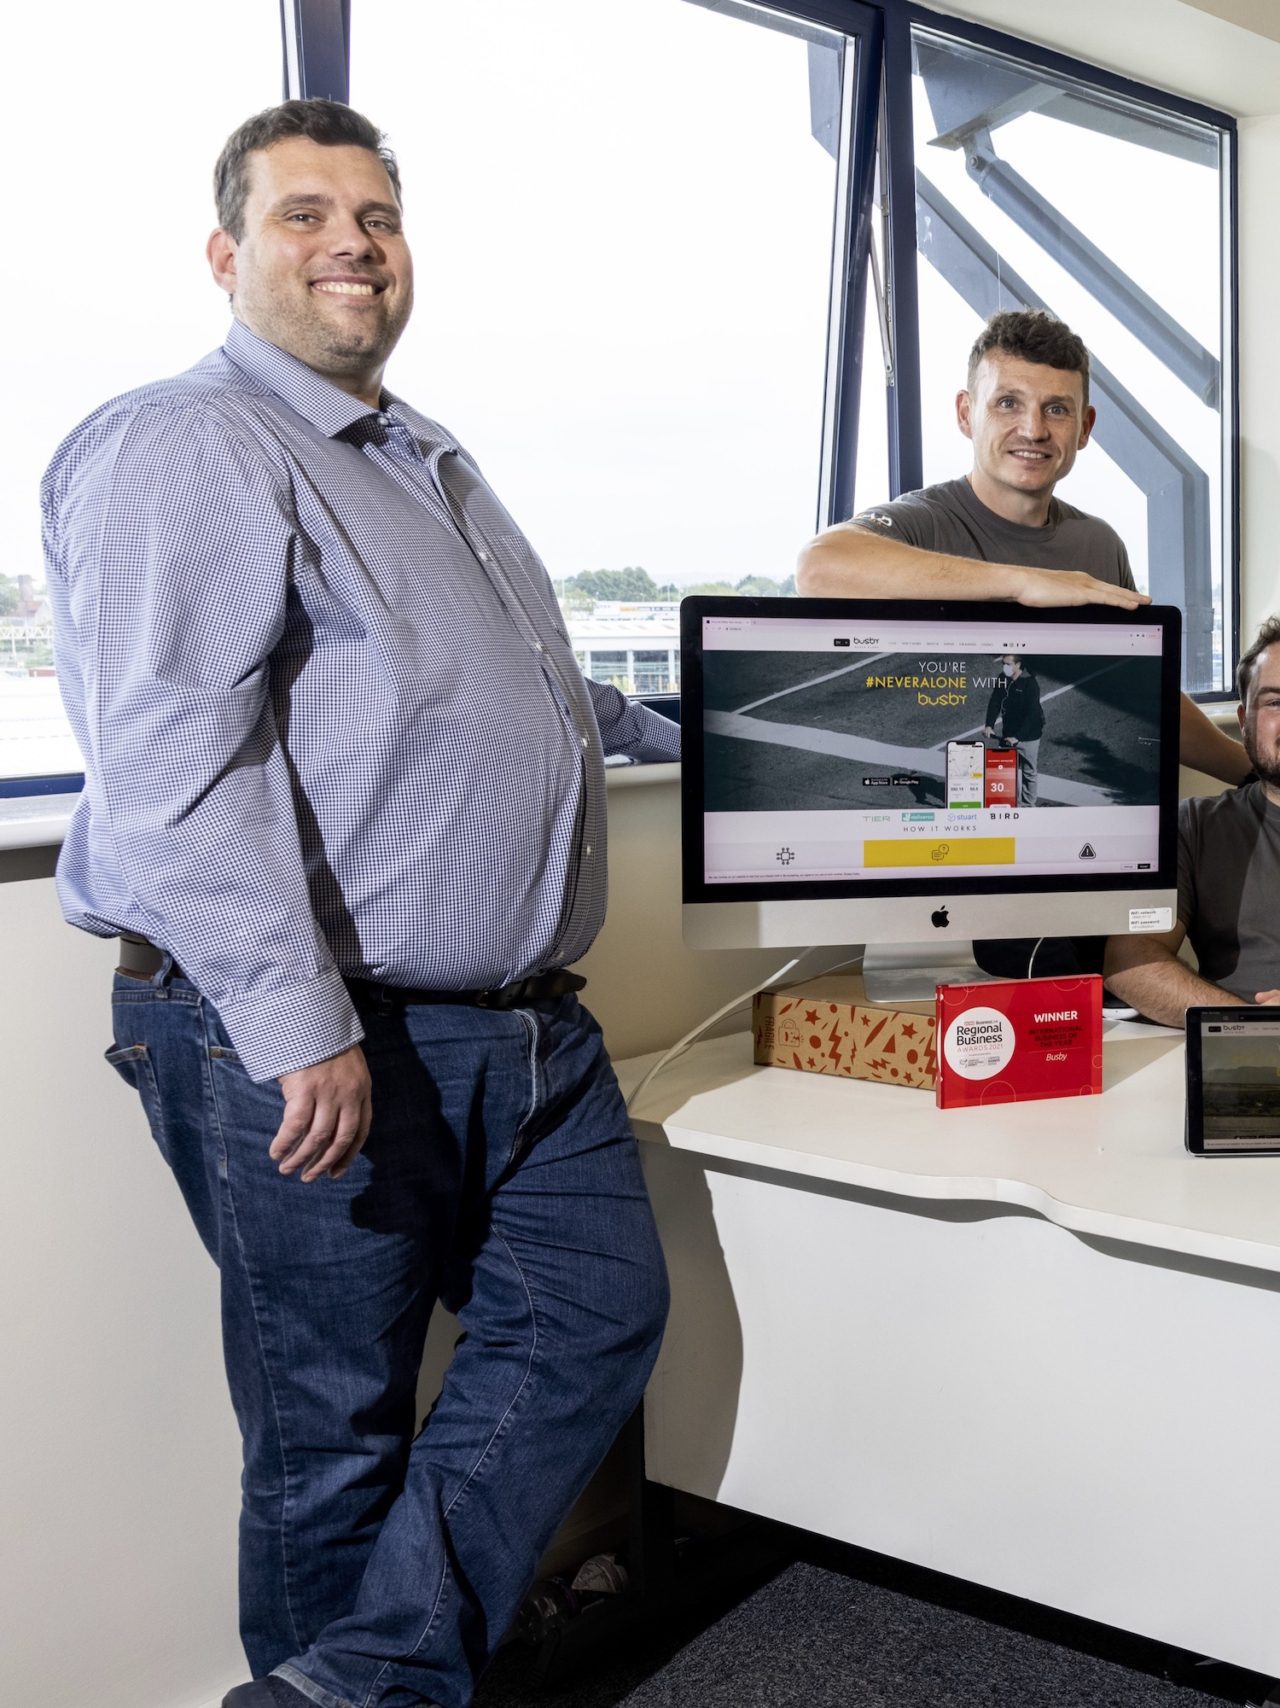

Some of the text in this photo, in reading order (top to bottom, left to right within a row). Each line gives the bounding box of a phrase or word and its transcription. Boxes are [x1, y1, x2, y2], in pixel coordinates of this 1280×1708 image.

[918, 661, 966, 673] YOU'RE
[865, 676, 1007, 689] #NEVERALONE WITH
[990, 782, 1005, 793] 30
[990, 812, 1020, 820] BIRD
[1033, 1010, 1078, 1023] WINNER
[956, 1021, 1003, 1037] Regional
[956, 1034, 1003, 1046] Business
[957, 1045, 988, 1053] AWARDS
[1046, 1051, 1068, 1062] Busby
